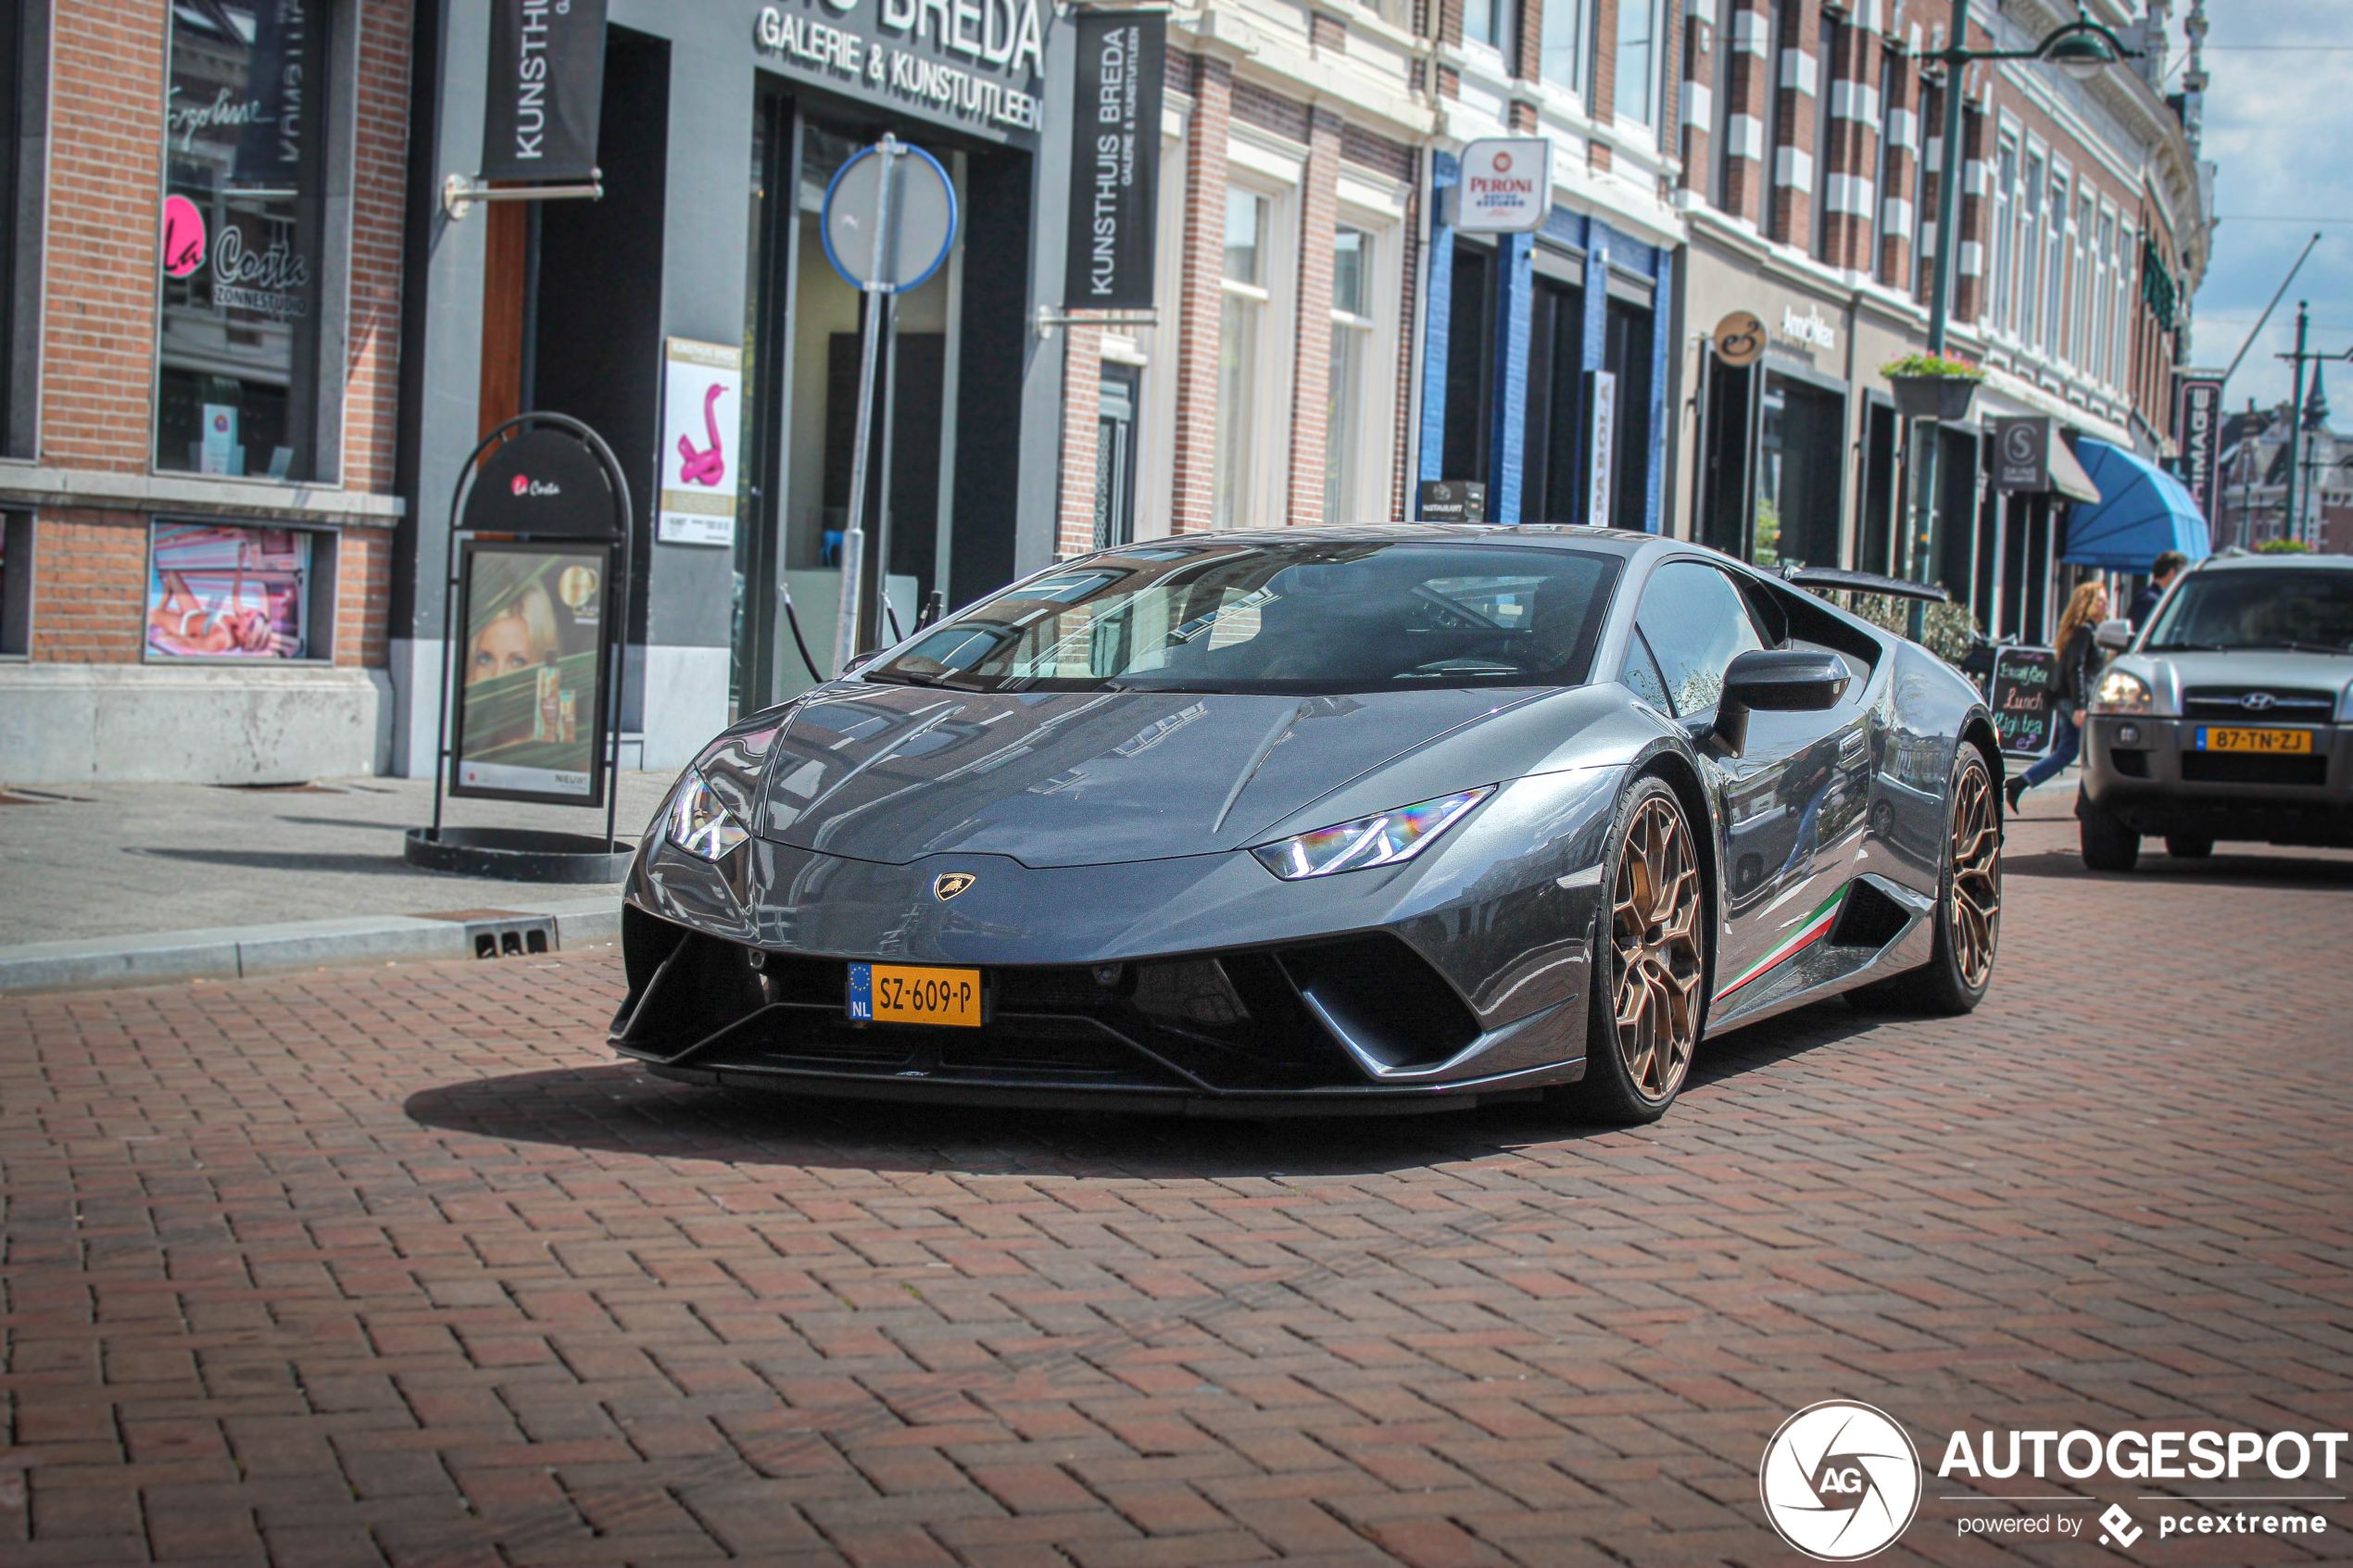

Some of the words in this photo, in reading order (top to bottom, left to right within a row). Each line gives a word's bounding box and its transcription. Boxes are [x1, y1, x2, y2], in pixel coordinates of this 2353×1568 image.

[516, 0, 549, 159] KUNSTH
[760, 6, 862, 74] GALERIE
[868, 44, 885, 82] &
[891, 50, 1044, 132] KUNSTUITLEEN
[1099, 28, 1125, 123] BREDA
[1121, 133, 1135, 186] GALERIE
[1470, 177, 1532, 193] PERONI
[1091, 133, 1119, 295] KUNSTHUIS
[213, 225, 310, 289] Costa
[214, 285, 307, 317] ZONNESTUDIO
[2004, 687, 2044, 710] Lunch
[2021, 713, 2043, 734] tea
[2216, 731, 2302, 749] 87-TN-ZJ
[852, 1001, 871, 1018] NL
[880, 977, 971, 1013] SZ-609-P
